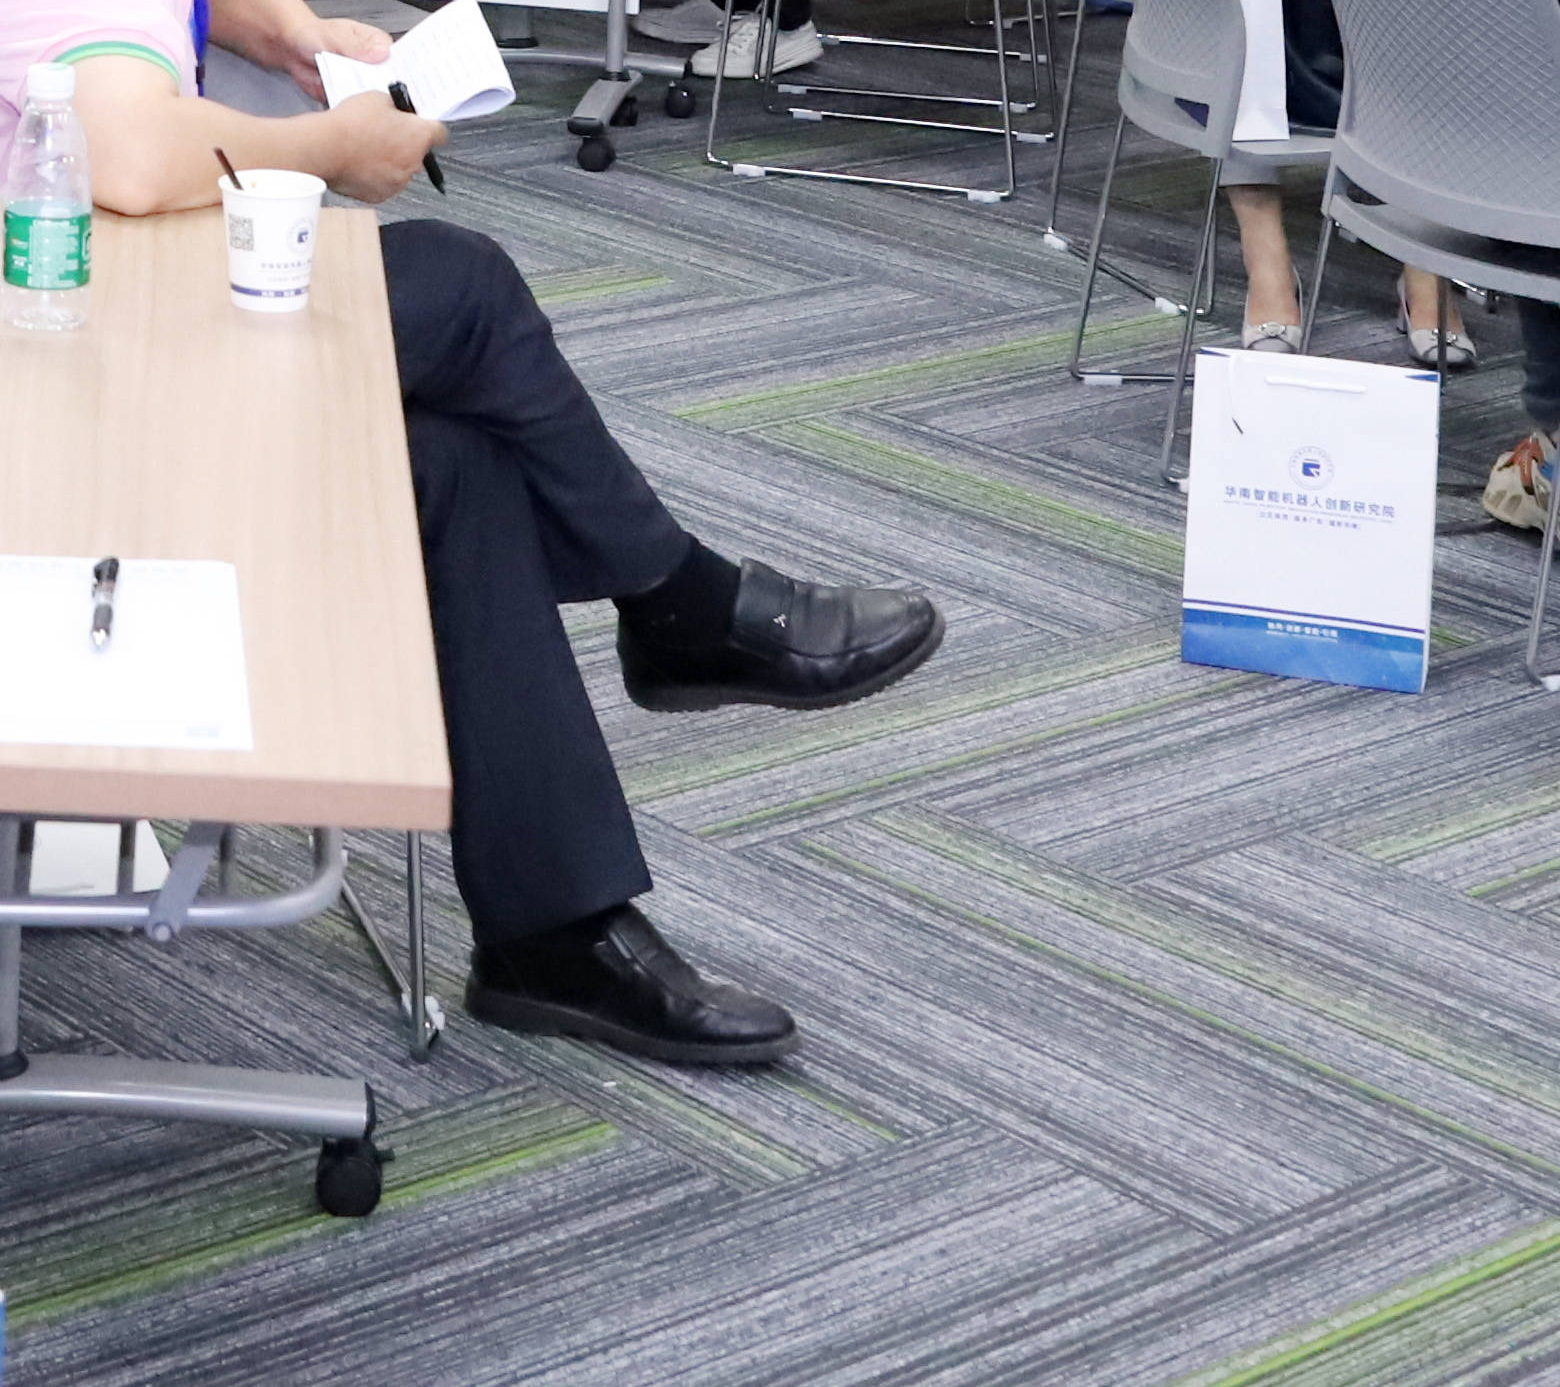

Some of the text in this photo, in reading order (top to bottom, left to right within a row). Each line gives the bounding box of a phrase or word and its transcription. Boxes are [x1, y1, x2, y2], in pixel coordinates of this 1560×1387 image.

[1224, 485, 1396, 519] 华南智能机器人创新研究院
